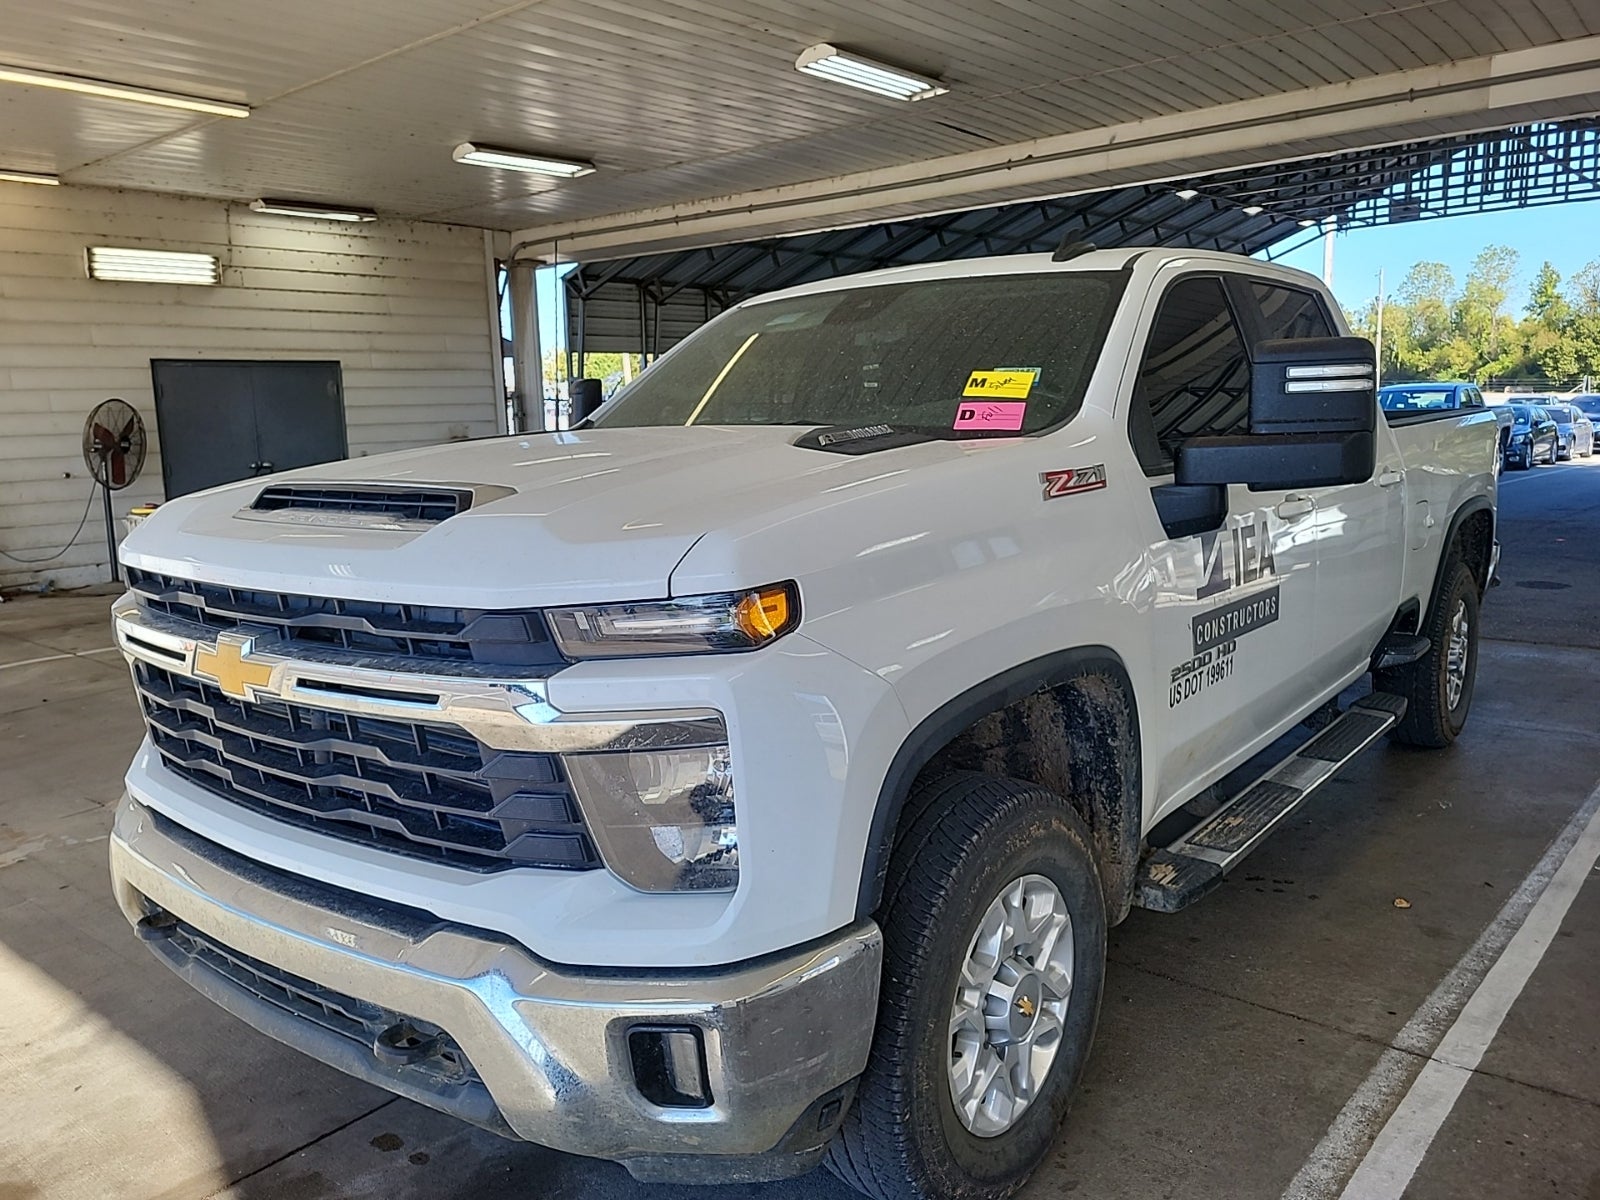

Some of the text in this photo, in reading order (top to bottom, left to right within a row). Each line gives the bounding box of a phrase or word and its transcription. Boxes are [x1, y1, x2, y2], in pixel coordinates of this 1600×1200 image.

[969, 378, 987, 388] M
[959, 410, 975, 421] D
[1196, 596, 1276, 645] CONSTRUCTORS
[1169, 655, 1234, 708] US DOT 199611
[1170, 651, 1213, 683] 2500
